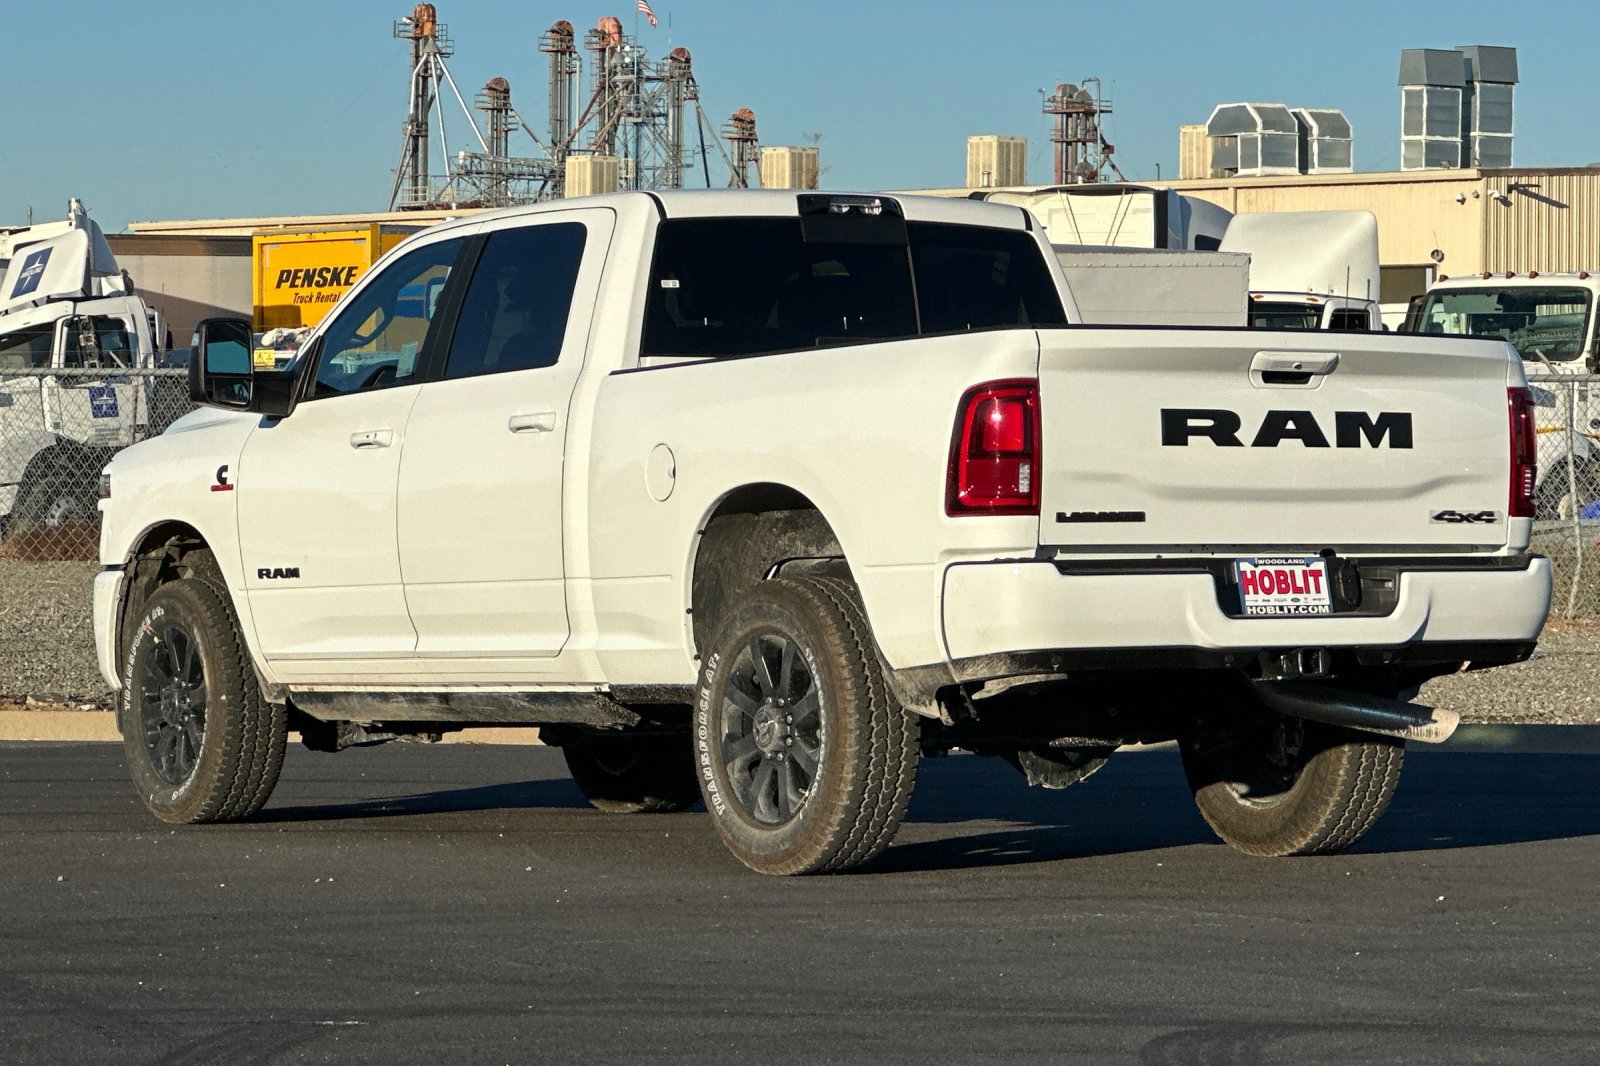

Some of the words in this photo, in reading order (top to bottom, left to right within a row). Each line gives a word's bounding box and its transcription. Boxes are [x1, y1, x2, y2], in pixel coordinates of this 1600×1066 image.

[275, 266, 359, 289] PENSKE
[293, 292, 314, 304] Truck
[315, 291, 341, 304] Rental
[1160, 408, 1413, 449] RAM
[257, 567, 300, 579] RAM
[1241, 569, 1322, 595] HOBLIT
[1247, 605, 1329, 614] HOBLIT.COM
